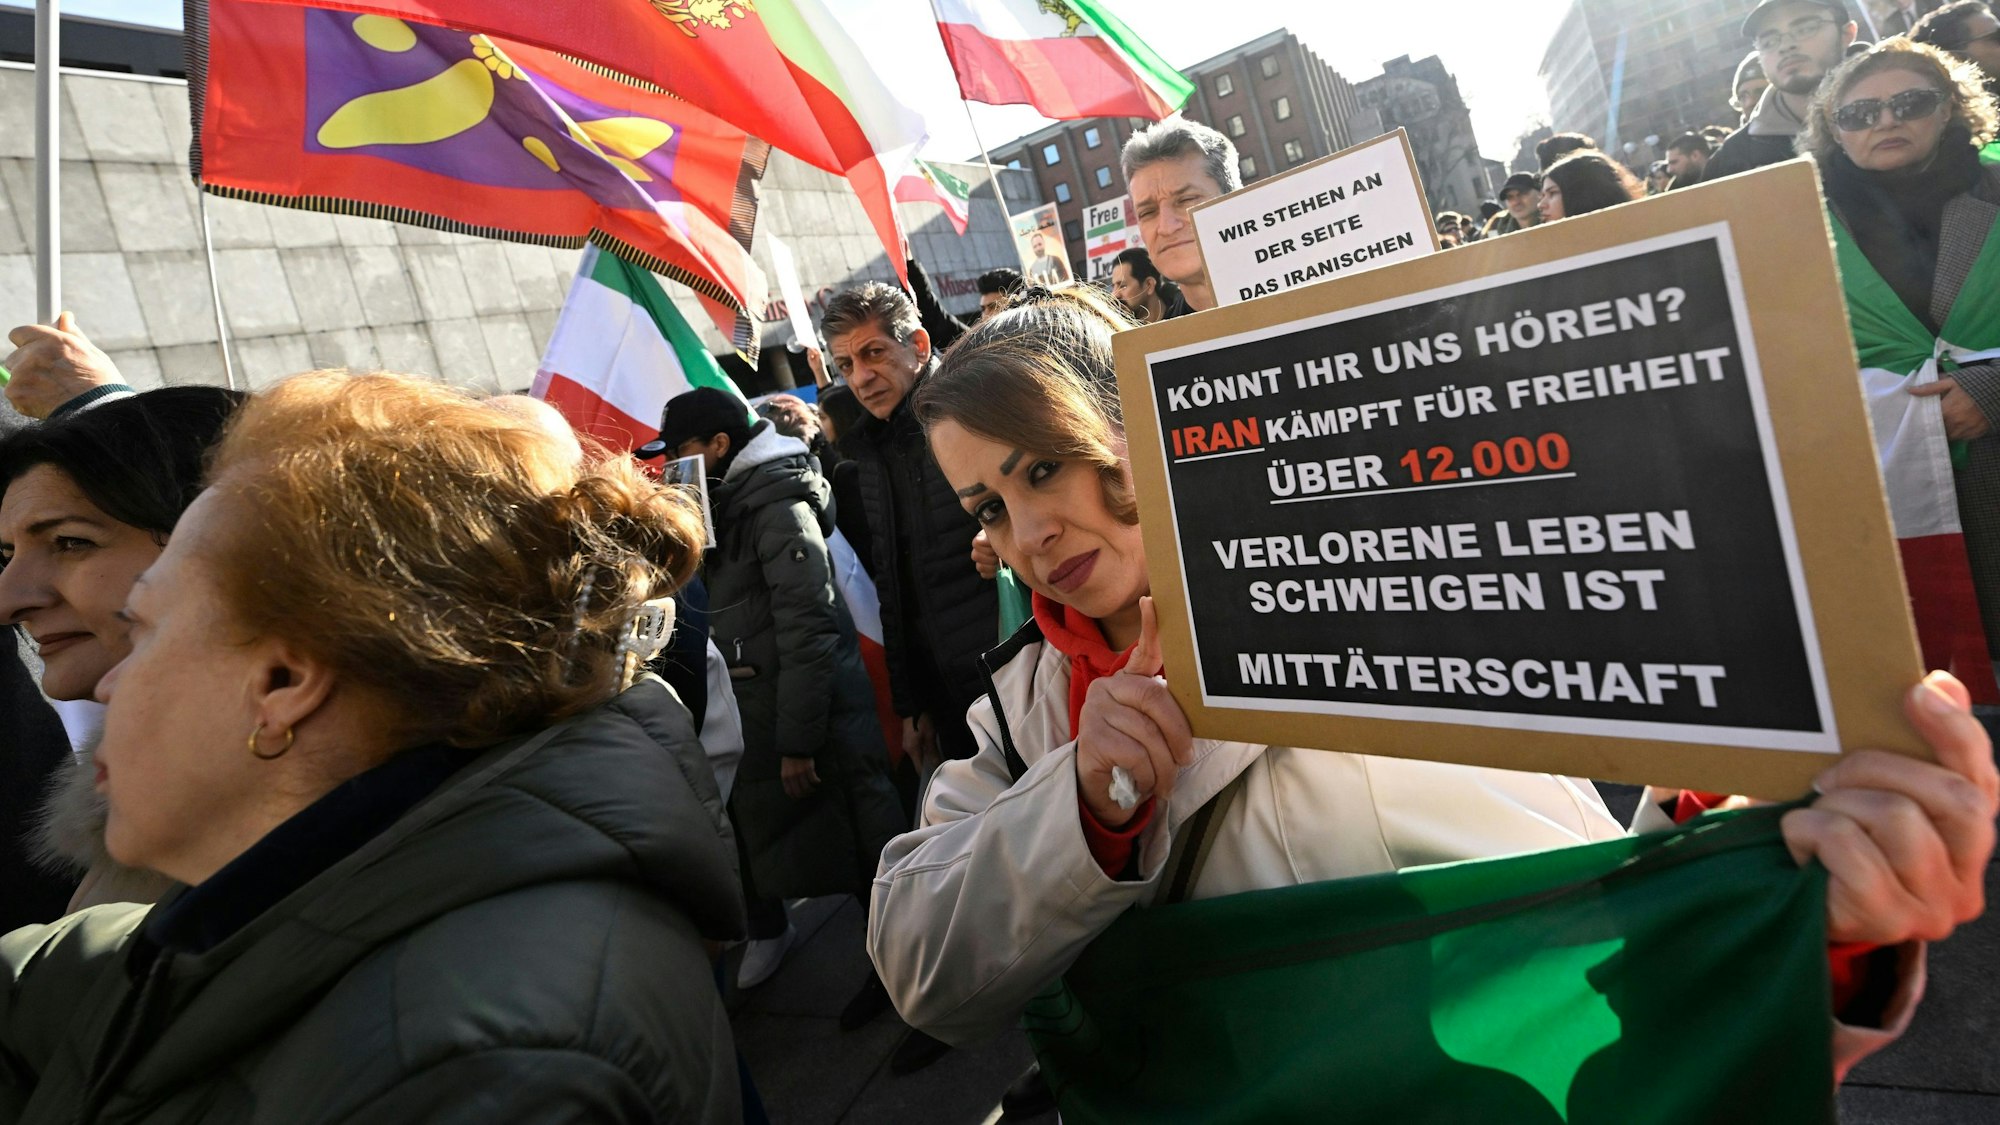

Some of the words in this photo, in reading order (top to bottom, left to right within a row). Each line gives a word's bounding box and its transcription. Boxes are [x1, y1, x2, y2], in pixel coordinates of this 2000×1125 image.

[1090, 206, 1118, 228] Free
[1219, 219, 1258, 243] WIR
[1263, 186, 1345, 228] STEHEN
[1352, 172, 1383, 196] AN
[1092, 257, 1113, 280] Ira
[1239, 278, 1279, 301] DAS
[1284, 231, 1414, 287] IRANISCHEN
[1254, 239, 1297, 264] DER
[1301, 214, 1363, 247] SEITE
[936, 273, 979, 298] Museu
[1166, 366, 1283, 412] KÖNNT
[1299, 351, 1364, 390] IHR
[1371, 332, 1463, 376] UNS
[1474, 286, 1687, 357] HÖREN?
[1171, 416, 1261, 458] IRAN
[1264, 399, 1404, 445] KÄMPFT
[1413, 382, 1498, 424] FÜR
[1505, 347, 1732, 411] FREIHEIT
[1266, 453, 1389, 497] ÜBER
[1400, 432, 1570, 484] 12.000
[1212, 523, 1482, 570] VERLORENE
[1495, 510, 1696, 557] LEBEN
[1248, 571, 1546, 614] SCHWEIGEN
[1562, 569, 1666, 611] IST
[1237, 648, 1727, 708] MITTÄTERSCHAFT
